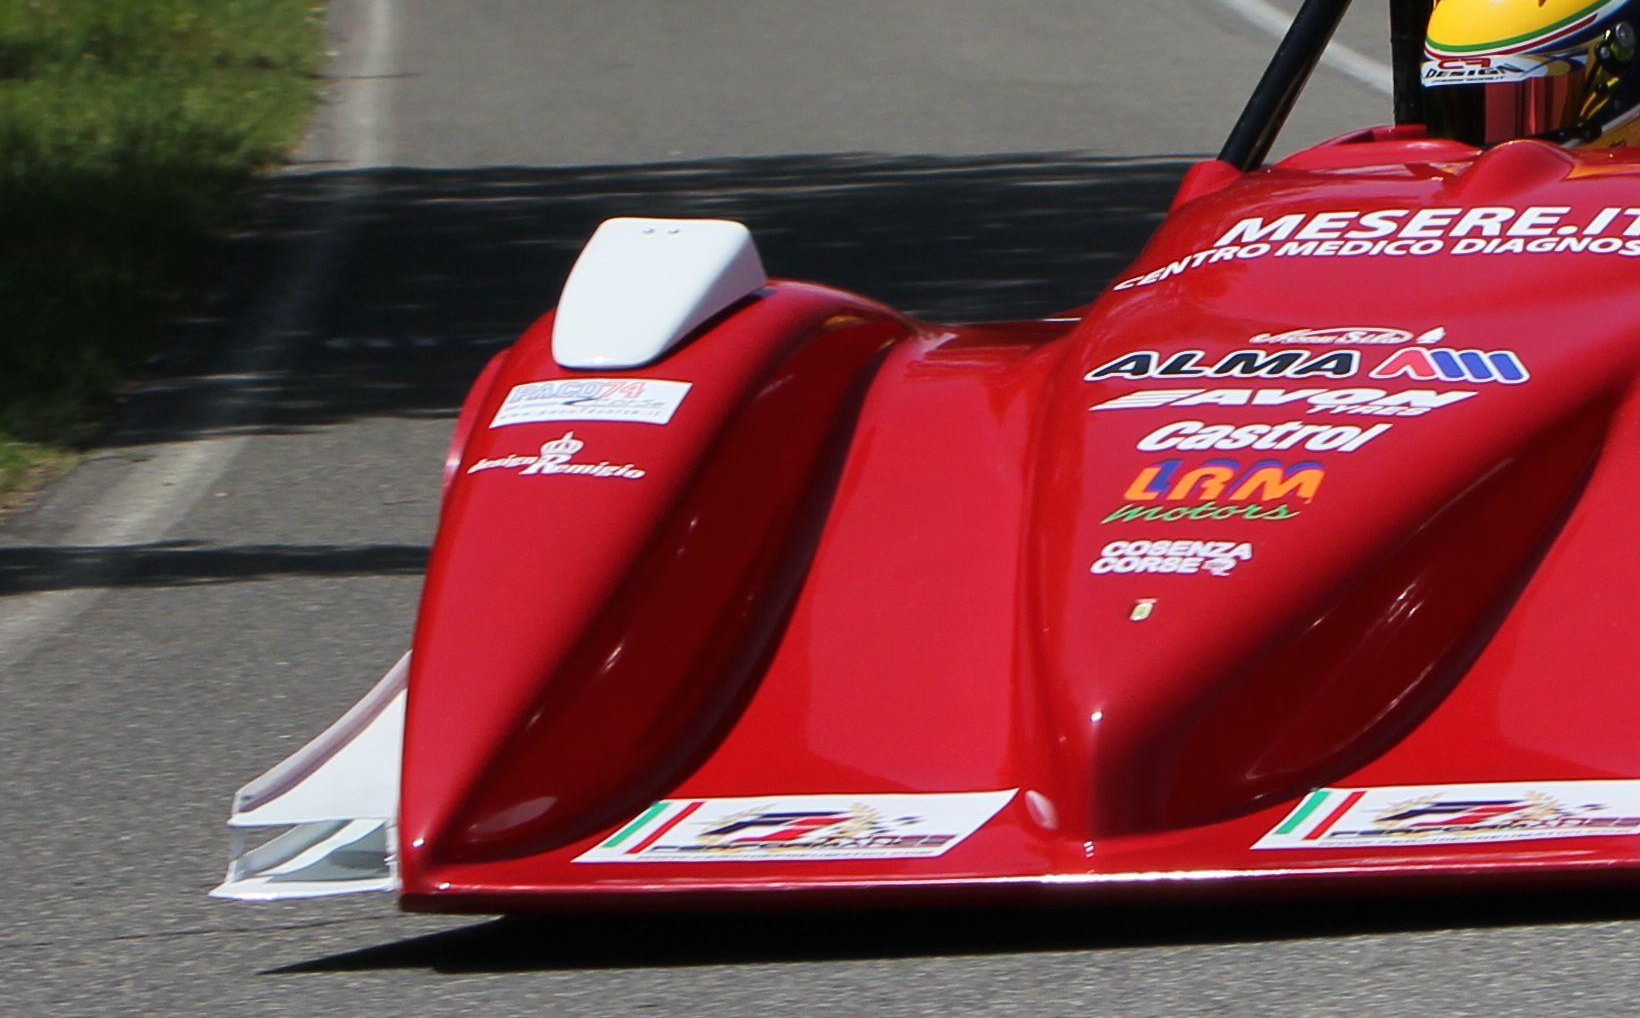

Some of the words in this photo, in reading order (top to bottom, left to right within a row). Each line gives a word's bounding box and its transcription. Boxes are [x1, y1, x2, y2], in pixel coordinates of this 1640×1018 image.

[1113, 242, 1268, 290] CENTRO
[1275, 239, 1443, 257] MEDICO
[1084, 349, 1361, 380] ALMA
[1165, 388, 1479, 409] AVON
[1307, 403, 1434, 416] TYRES
[1137, 421, 1393, 452] Castrol
[518, 454, 646, 479] Remigio
[1124, 458, 1328, 503] LRM
[1101, 501, 1300, 525] motors
[1101, 539, 1254, 561] COSENZA
[1090, 557, 1204, 574] CORSE
